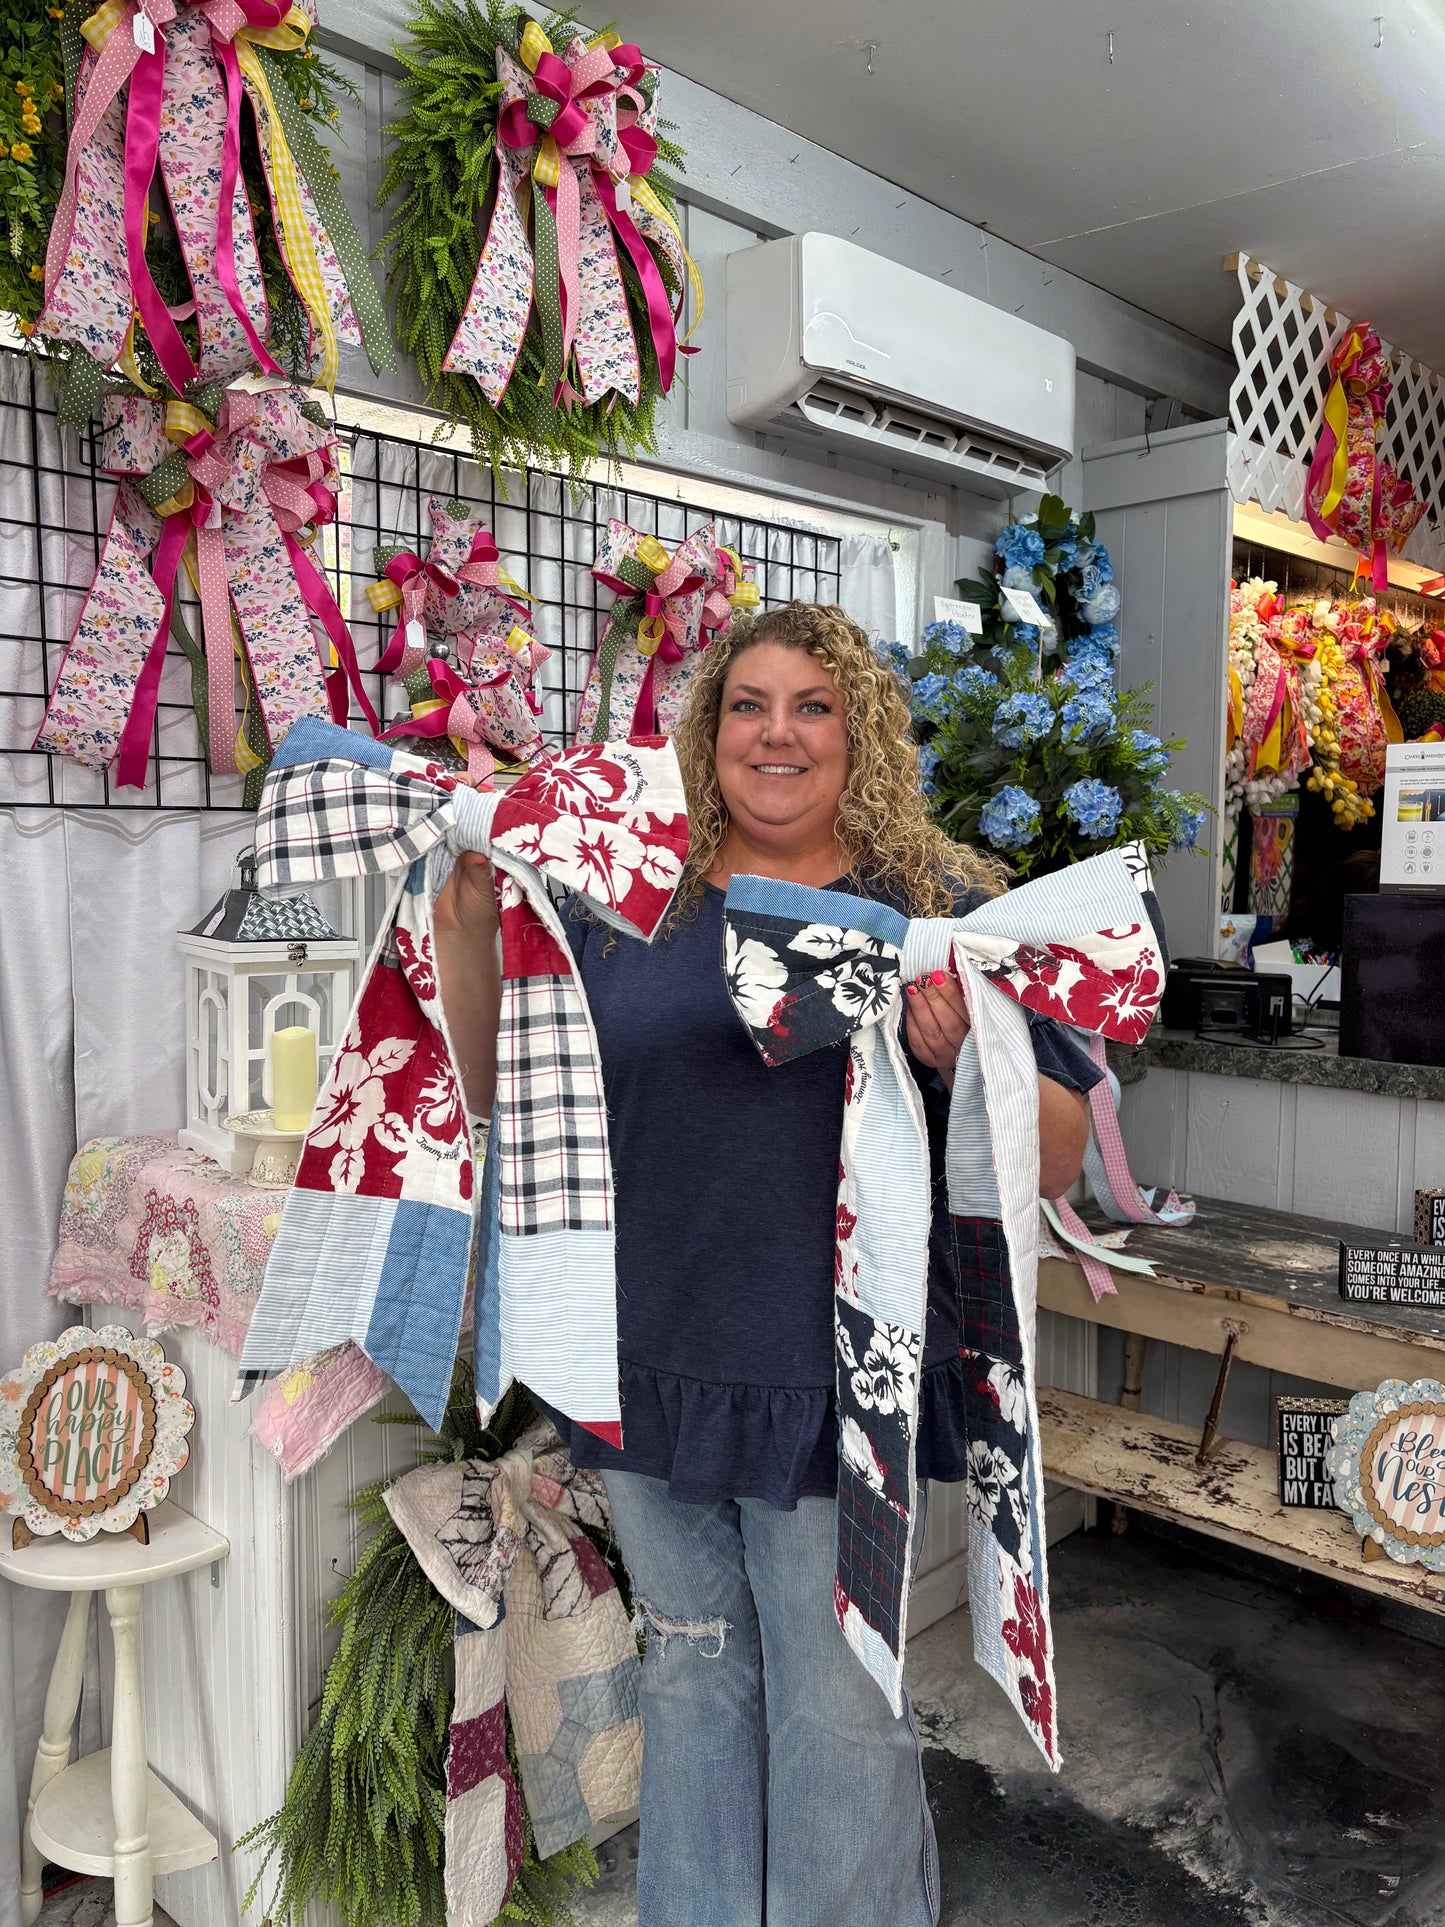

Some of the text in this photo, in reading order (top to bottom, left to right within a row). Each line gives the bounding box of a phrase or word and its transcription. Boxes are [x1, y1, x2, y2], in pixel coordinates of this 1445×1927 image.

[612, 753, 649, 806] Tommy Hilfiger
[853, 1071, 873, 1104] Tommy
[416, 1136, 443, 1161] Tommy
[1347, 1260, 1397, 1276] SOMEONE
[1348, 1249, 1376, 1261] EVERY
[1377, 1251, 1400, 1263] ONCE
[1401, 1252, 1411, 1264] IN
[1412, 1253, 1419, 1264] A
[1347, 1273, 1376, 1285] COMES
[1377, 1275, 1396, 1287] INTO
[1398, 1277, 1420, 1289] YOUR
[1347, 1284, 1388, 1301] YOU'RE
[66, 1377, 119, 1411] OUR
[41, 1391, 136, 1447] happy
[1282, 1413, 1318, 1433] EVERY
[1283, 1433, 1299, 1456] IS
[43, 1437, 130, 1488] PLACE
[1285, 1456, 1318, 1481] BUT
[1283, 1480, 1309, 1504] MY
